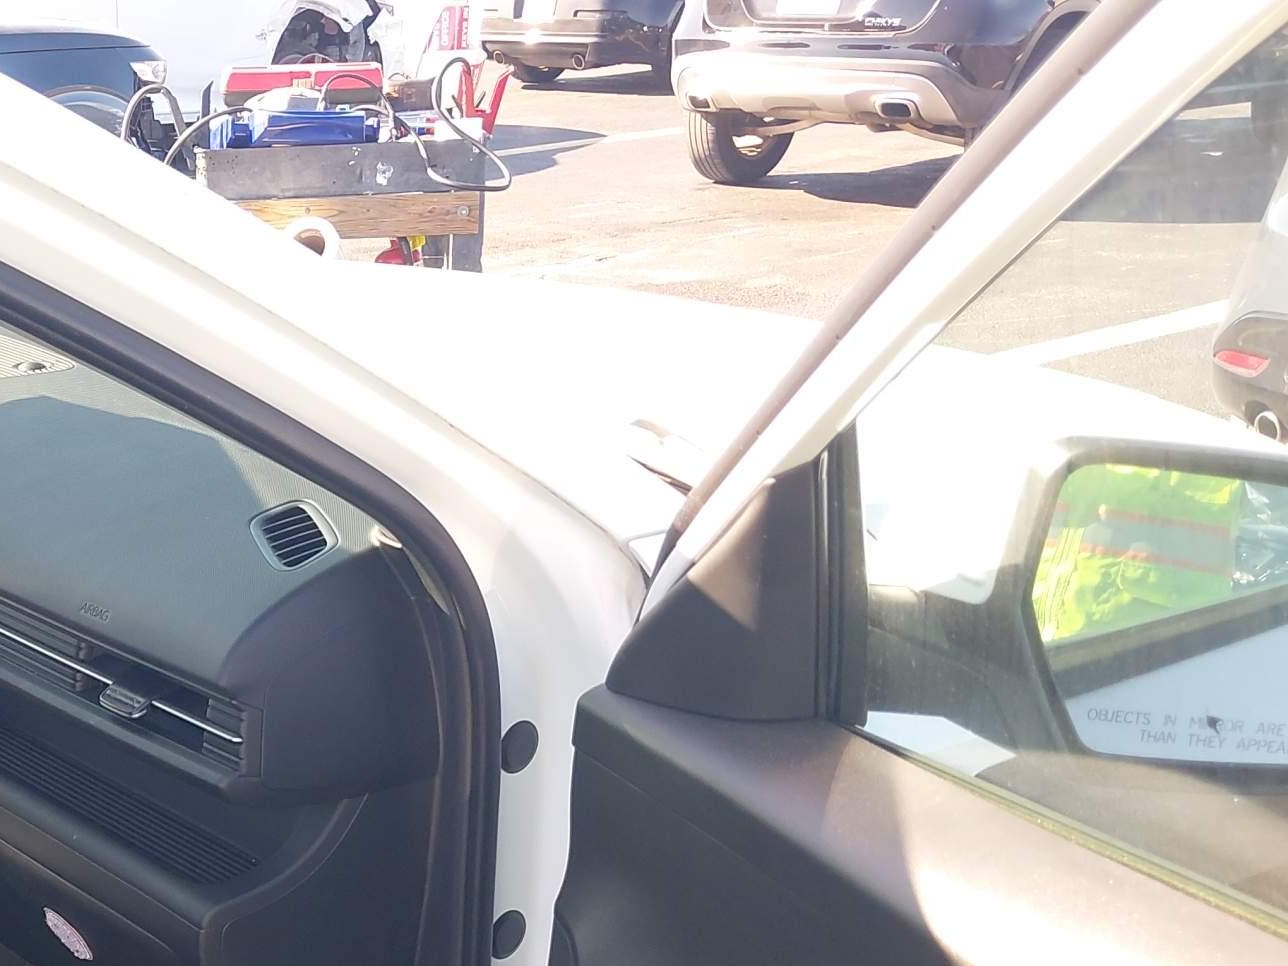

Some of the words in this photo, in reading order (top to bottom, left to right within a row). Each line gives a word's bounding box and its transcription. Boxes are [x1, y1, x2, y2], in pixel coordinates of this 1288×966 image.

[80, 600, 112, 624] AIRBAG
[1087, 708, 1152, 726] OBJECTS
[1163, 714, 1177, 727] IN
[1256, 722, 1288, 737] ARE
[1139, 729, 1176, 745] THAN
[1187, 733, 1227, 749] THEY
